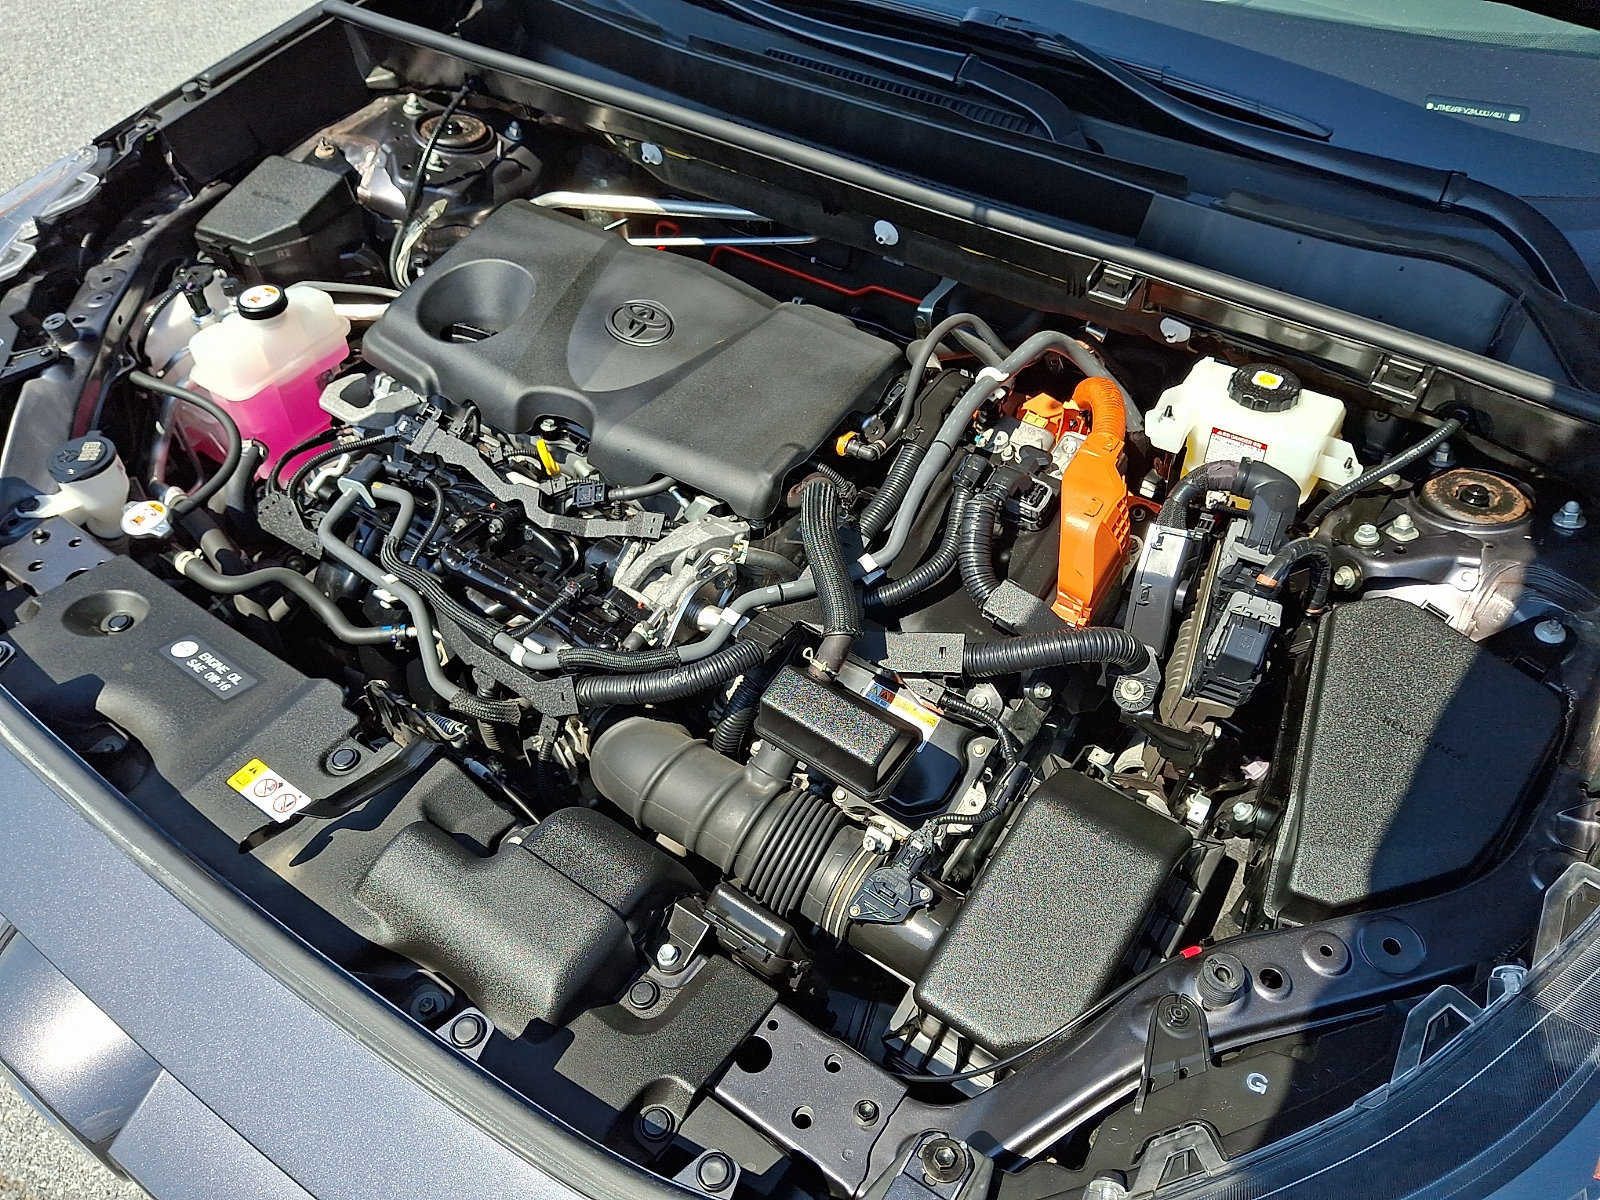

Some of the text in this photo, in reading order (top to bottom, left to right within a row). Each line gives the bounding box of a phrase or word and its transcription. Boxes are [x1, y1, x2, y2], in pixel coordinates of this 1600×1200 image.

[186, 658, 232, 692] SAE 0W-16
[198, 652, 243, 686] ENGINE OIL
